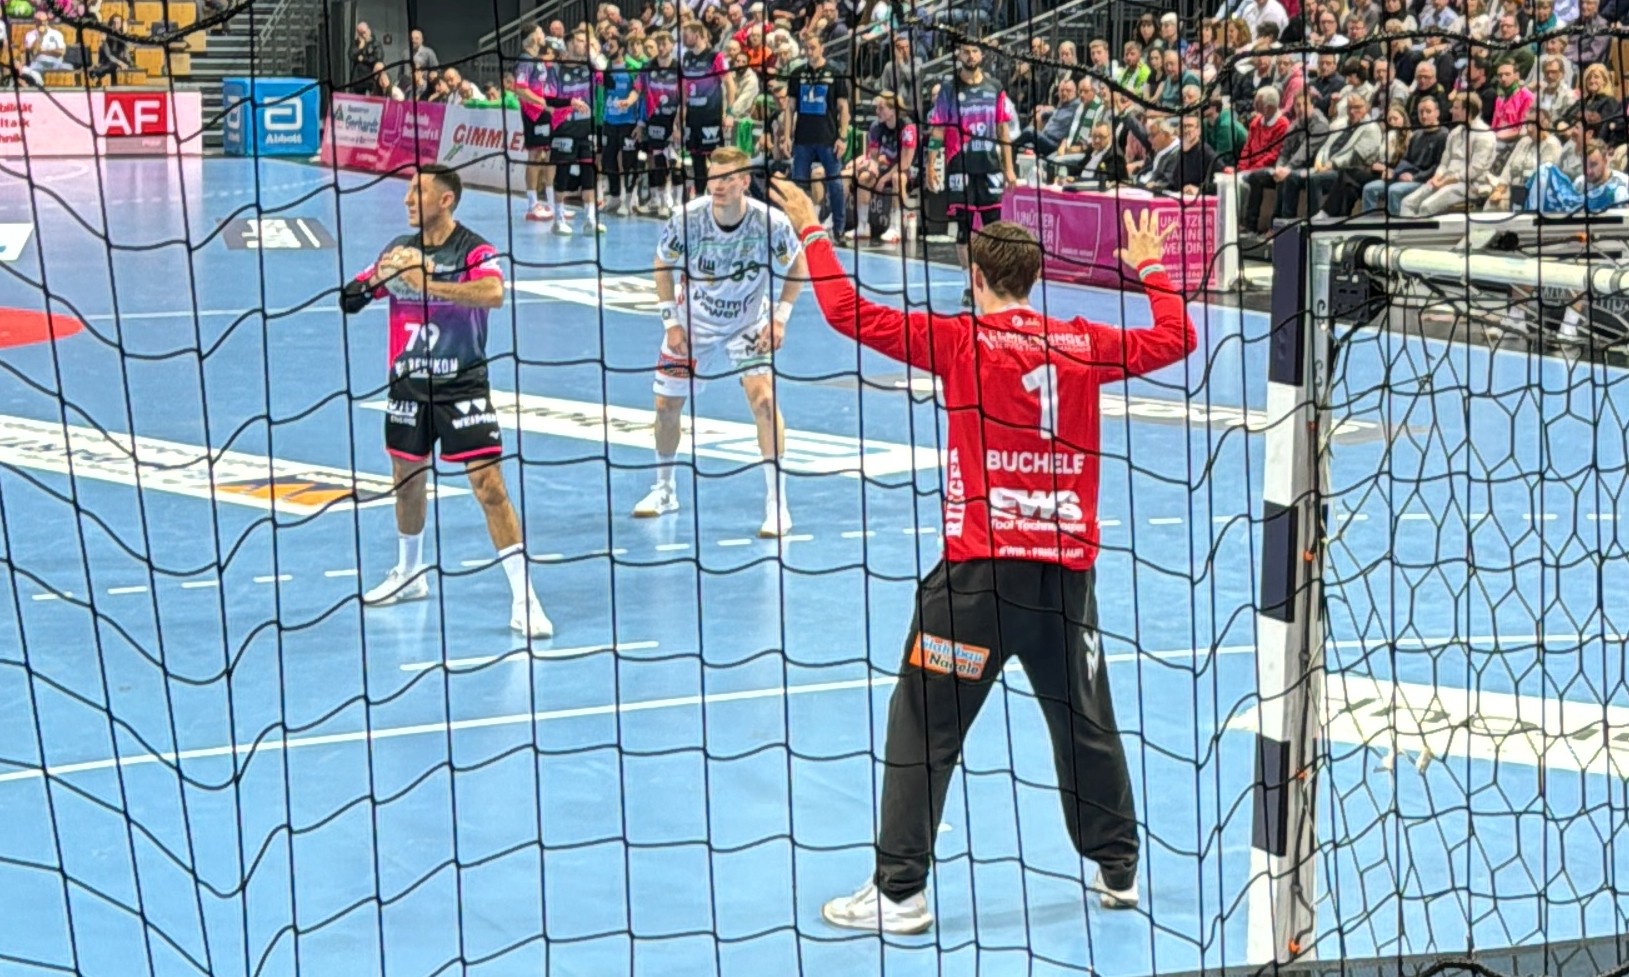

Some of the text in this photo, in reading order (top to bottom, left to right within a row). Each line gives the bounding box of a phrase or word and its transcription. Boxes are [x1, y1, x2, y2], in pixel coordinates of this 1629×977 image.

[105, 100, 160, 134] AF
[265, 133, 302, 144] Abbott
[453, 123, 527, 152] GIMME
[1160, 214, 1212, 228] UNTZER
[1163, 241, 1212, 254] WEDING
[404, 322, 440, 352] 79
[1021, 363, 1058, 440] 1
[986, 449, 1086, 475] BUCHELE
[989, 487, 1083, 521] EWS
